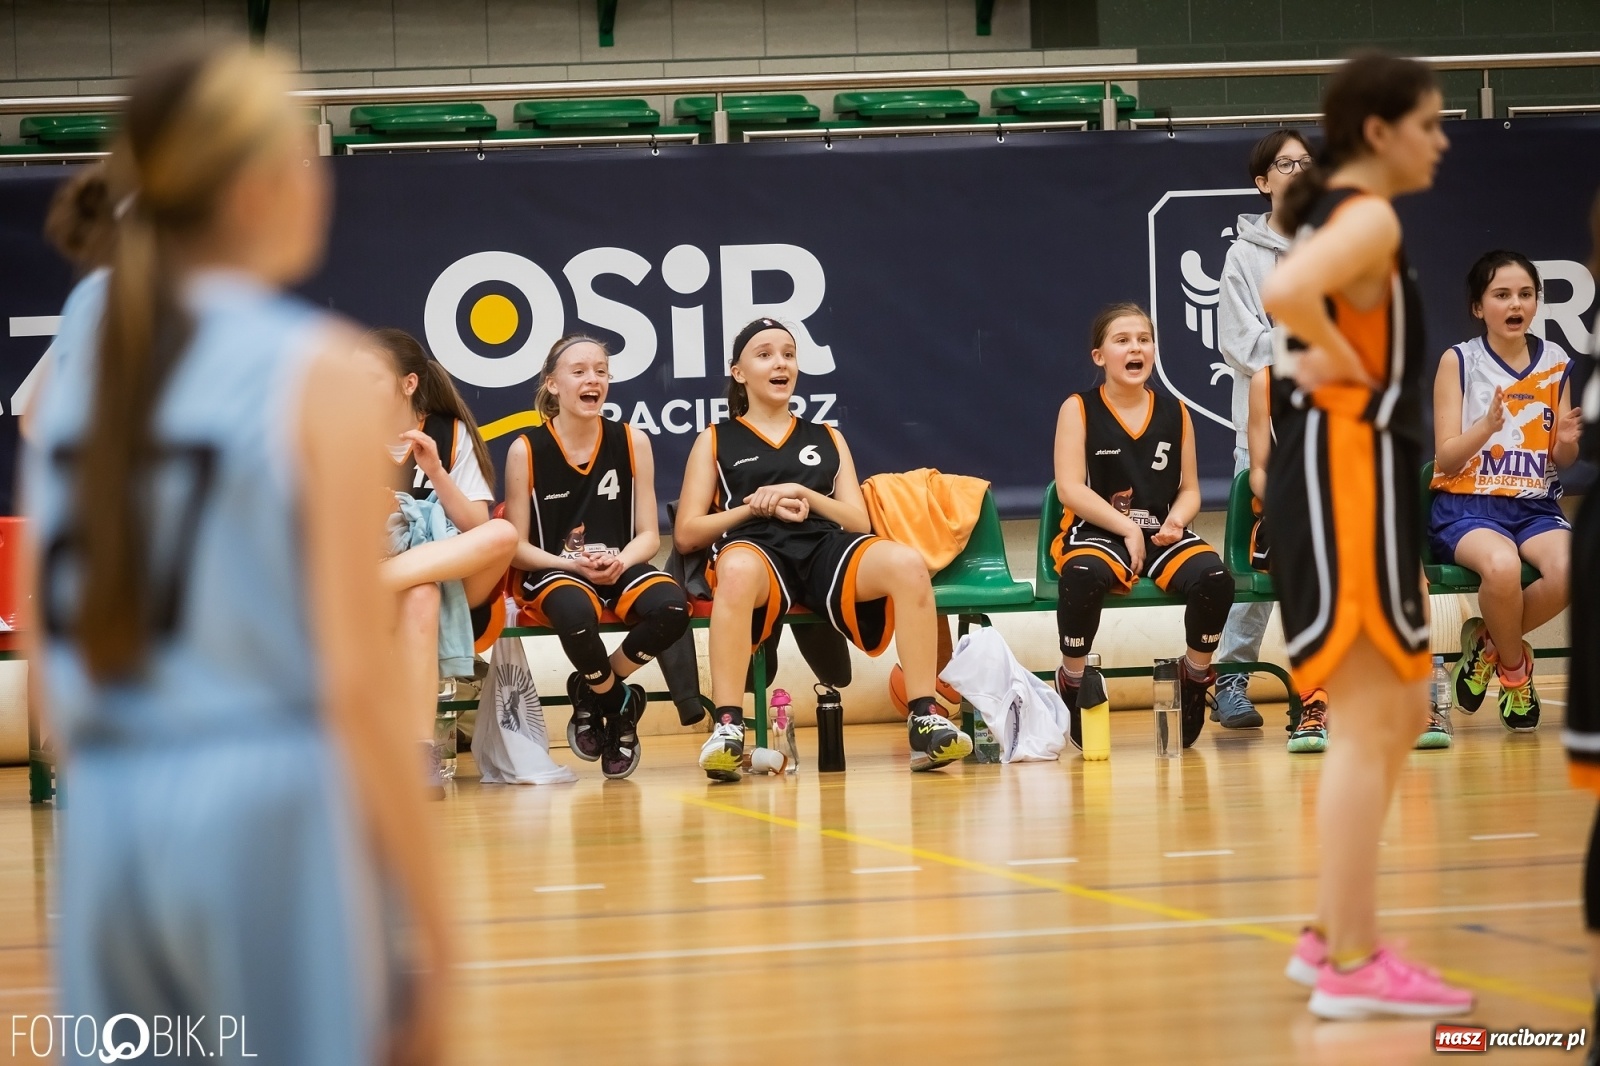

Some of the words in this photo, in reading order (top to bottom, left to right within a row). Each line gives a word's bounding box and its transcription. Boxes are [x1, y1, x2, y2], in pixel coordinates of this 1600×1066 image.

[424, 244, 836, 387] OSiR
[1543, 407, 1555, 431] 5
[798, 445, 822, 466] 6
[1151, 441, 1172, 471] 5
[1480, 450, 1548, 478] MIN
[597, 469, 620, 500] 4
[1070, 637, 1084, 647] NBA
